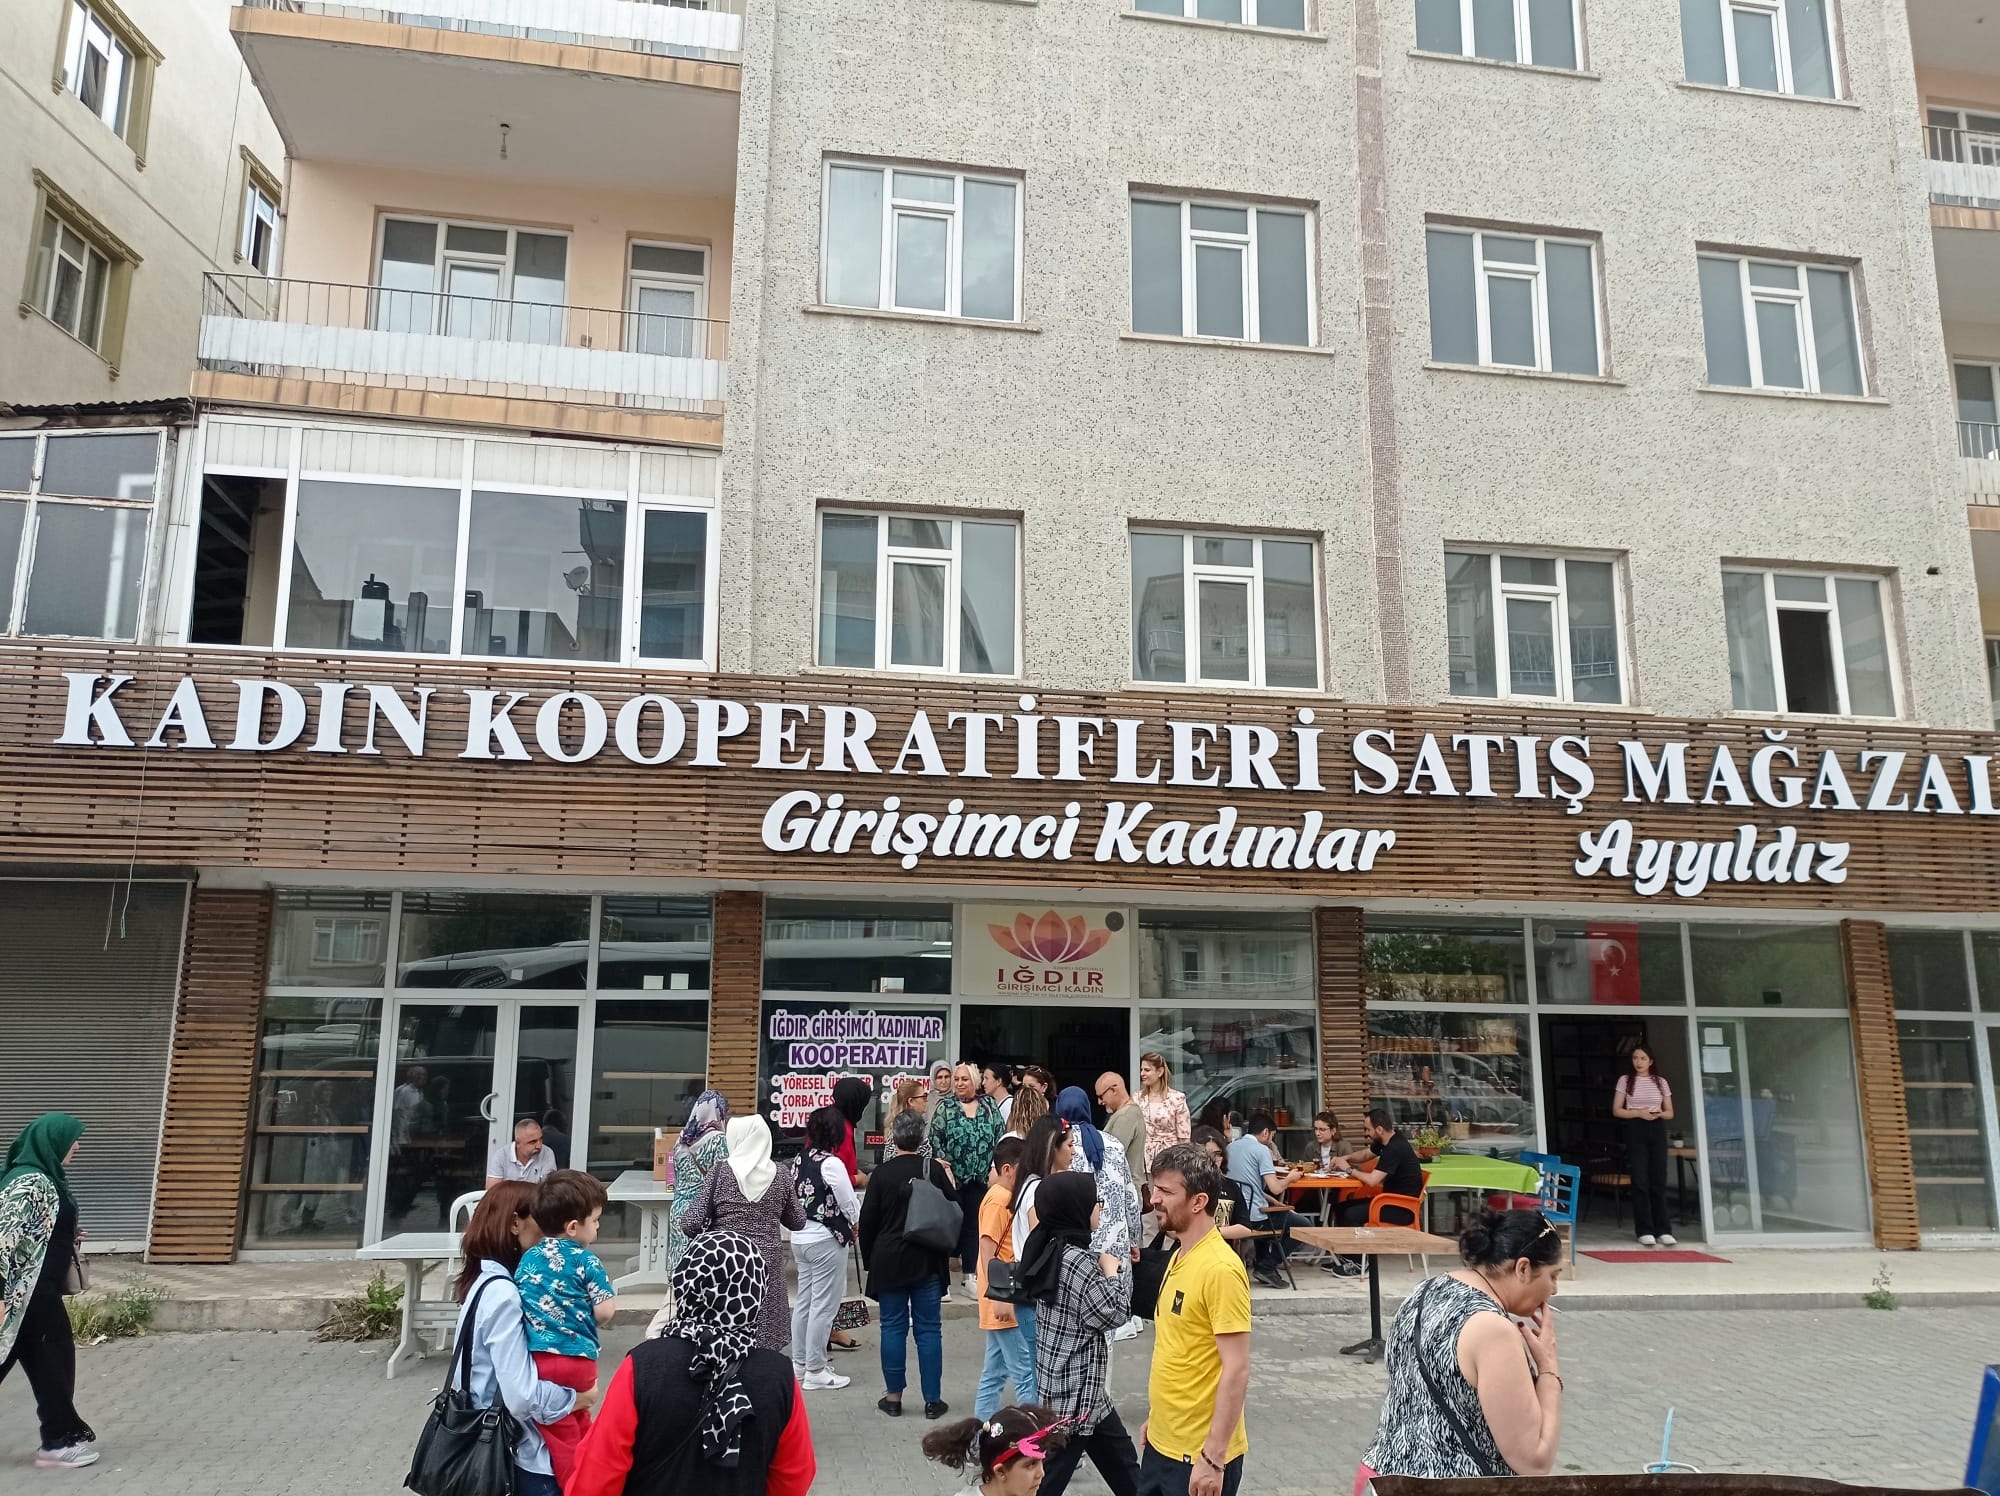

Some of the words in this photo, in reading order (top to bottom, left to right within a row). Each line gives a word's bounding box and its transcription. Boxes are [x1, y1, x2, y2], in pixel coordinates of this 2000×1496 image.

[53, 672, 438, 757] KADIN
[458, 688, 1325, 791] KOOPERATİFLERİ
[1352, 729, 1596, 815] SATIŞ
[760, 789, 1082, 871] Girişimci
[1093, 800, 1397, 872] Kadınlar
[1574, 819, 1851, 897] Ayyıldız
[997, 965, 1104, 986] IĞDIR
[997, 982, 1061, 994] GİRİŞİMCİ
[1064, 985, 1104, 994] KADIN
[772, 1011, 808, 1038] IĞDIR
[812, 1011, 874, 1043] GİRİŞİMCİ
[877, 1017, 941, 1039] KADINLAR
[791, 1041, 926, 1066] KOOPERATİFİ
[783, 1074, 826, 1090] YÖRESEL
[782, 1094, 815, 1111] ÇORBA
[781, 1112, 795, 1125] EV
